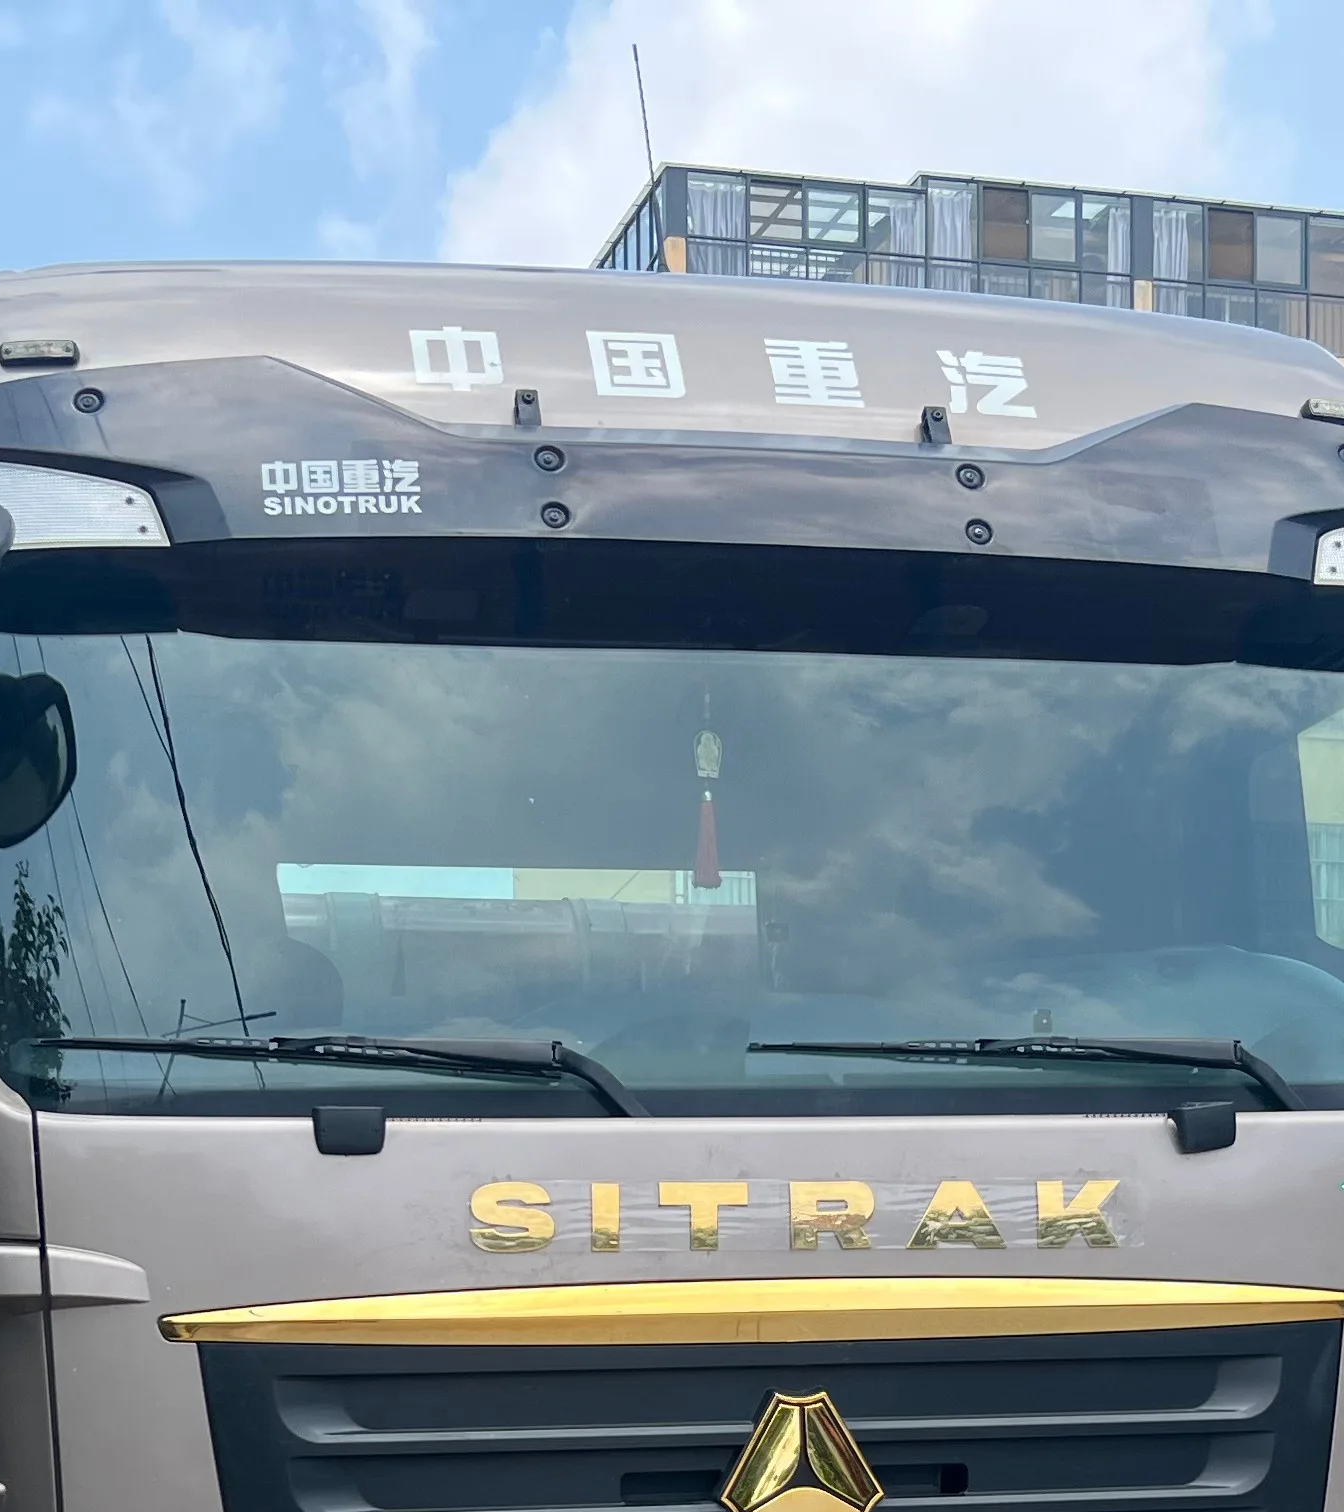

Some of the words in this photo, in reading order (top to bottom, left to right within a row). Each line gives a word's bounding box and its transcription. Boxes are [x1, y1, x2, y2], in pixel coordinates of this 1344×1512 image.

[408, 326, 1038, 419] 中国重汽
[261, 459, 421, 496] 中国重汽
[262, 495, 422, 517] SINOTRUK
[469, 1179, 1121, 1253] SITRAK
